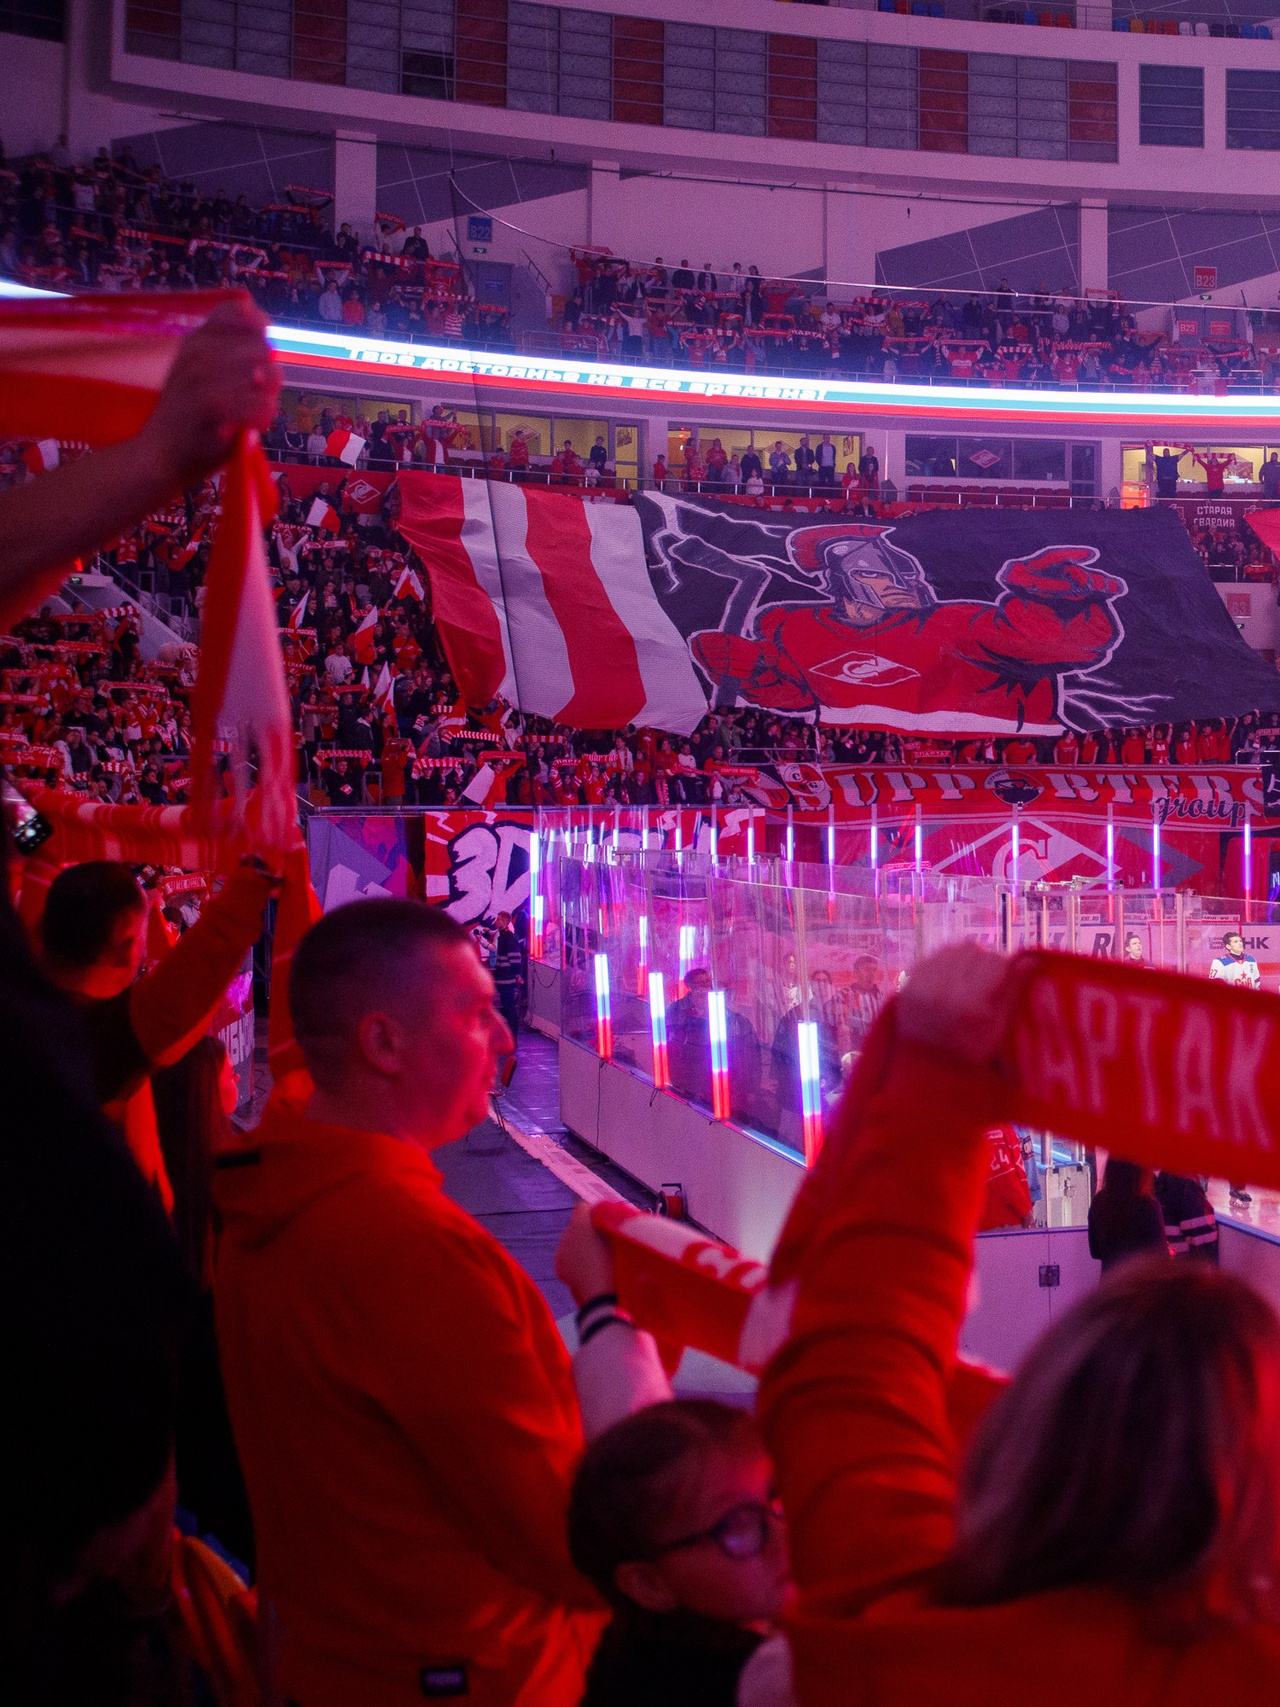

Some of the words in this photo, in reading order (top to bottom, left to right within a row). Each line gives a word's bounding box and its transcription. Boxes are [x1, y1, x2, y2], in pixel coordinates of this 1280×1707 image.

[470, 225, 490, 239] B22
[1197, 275, 1215, 288] B23
[1180, 325, 1195, 333] B23
[349, 349, 416, 368] Твоё
[420, 357, 581, 383] достоянье
[586, 374, 618, 387] на
[623, 377, 682, 392] все
[687, 380, 829, 401] времена!
[1197, 506, 1233, 515] СТАРАЯ
[1194, 517, 1235, 528] ГВАРДИЯ
[1151, 793, 1248, 830] group
[1024, 966, 1274, 1152] АРТАК
